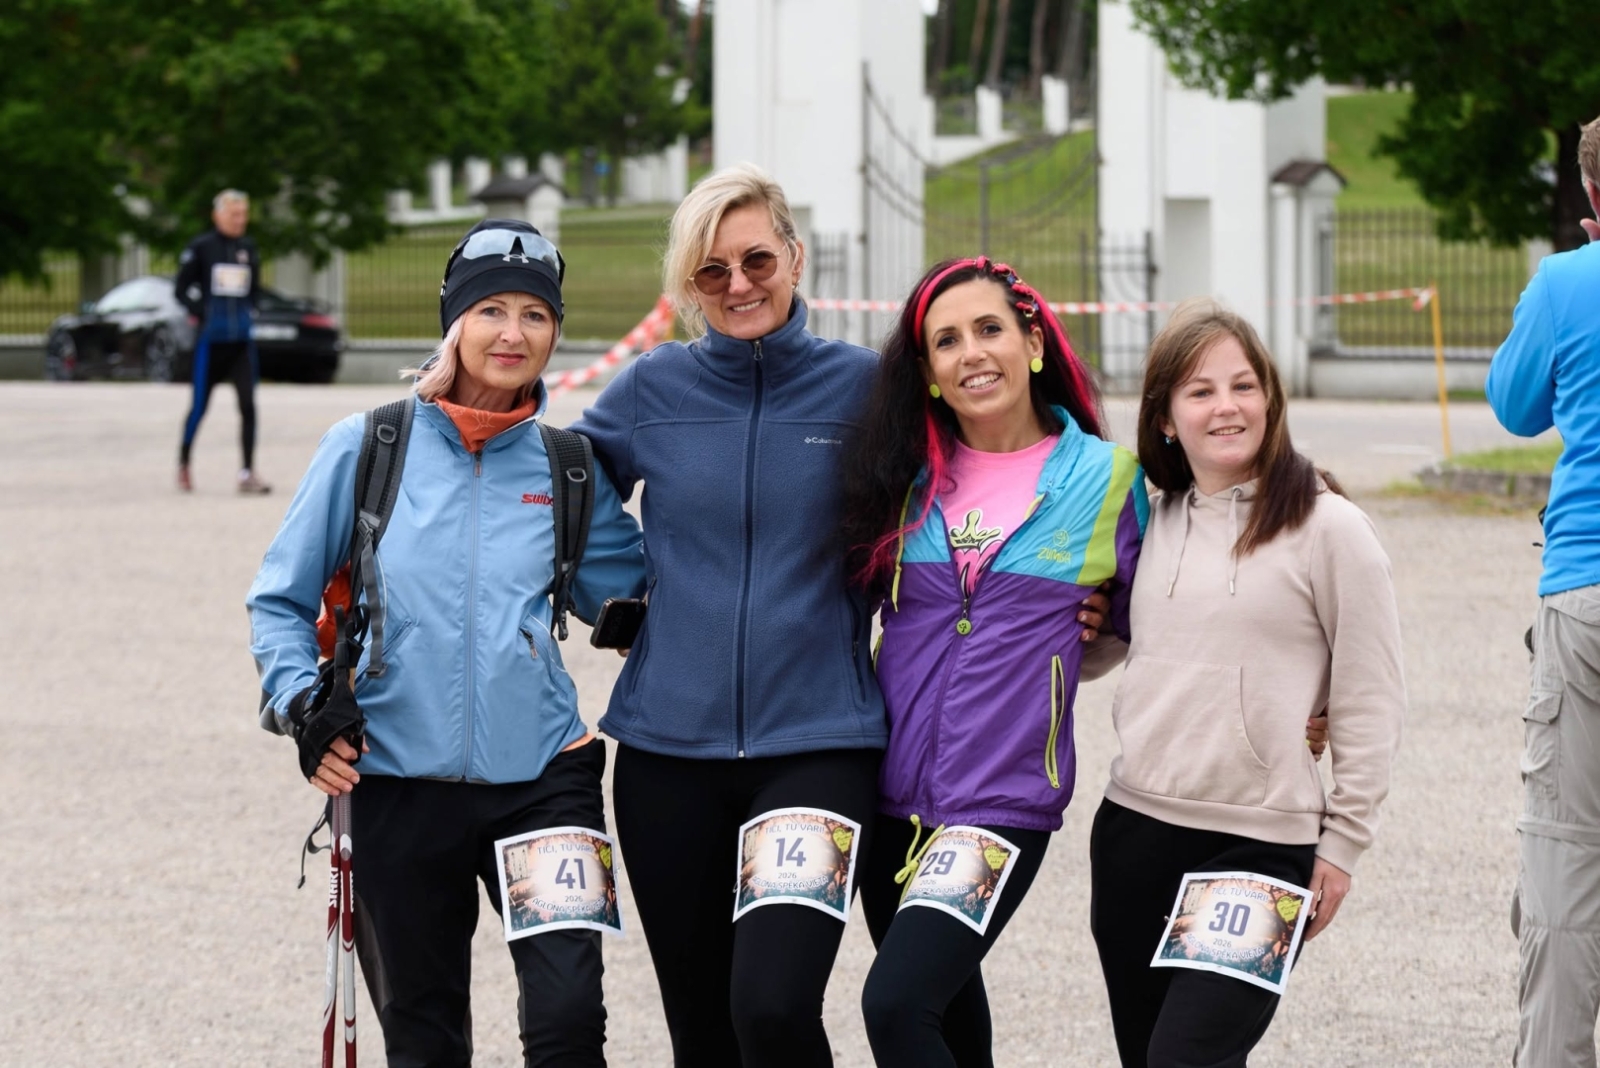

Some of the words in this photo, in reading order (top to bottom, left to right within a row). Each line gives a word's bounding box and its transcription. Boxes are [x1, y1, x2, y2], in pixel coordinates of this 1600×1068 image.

[786, 823, 798, 831] TU
[560, 843, 574, 852] TU
[775, 837, 807, 867] 14
[918, 850, 957, 878] 29
[555, 858, 587, 890] 41
[1230, 887, 1242, 896] TU
[564, 895, 584, 903] 2026
[1208, 901, 1251, 937] 30
[1213, 938, 1232, 947] 2026
